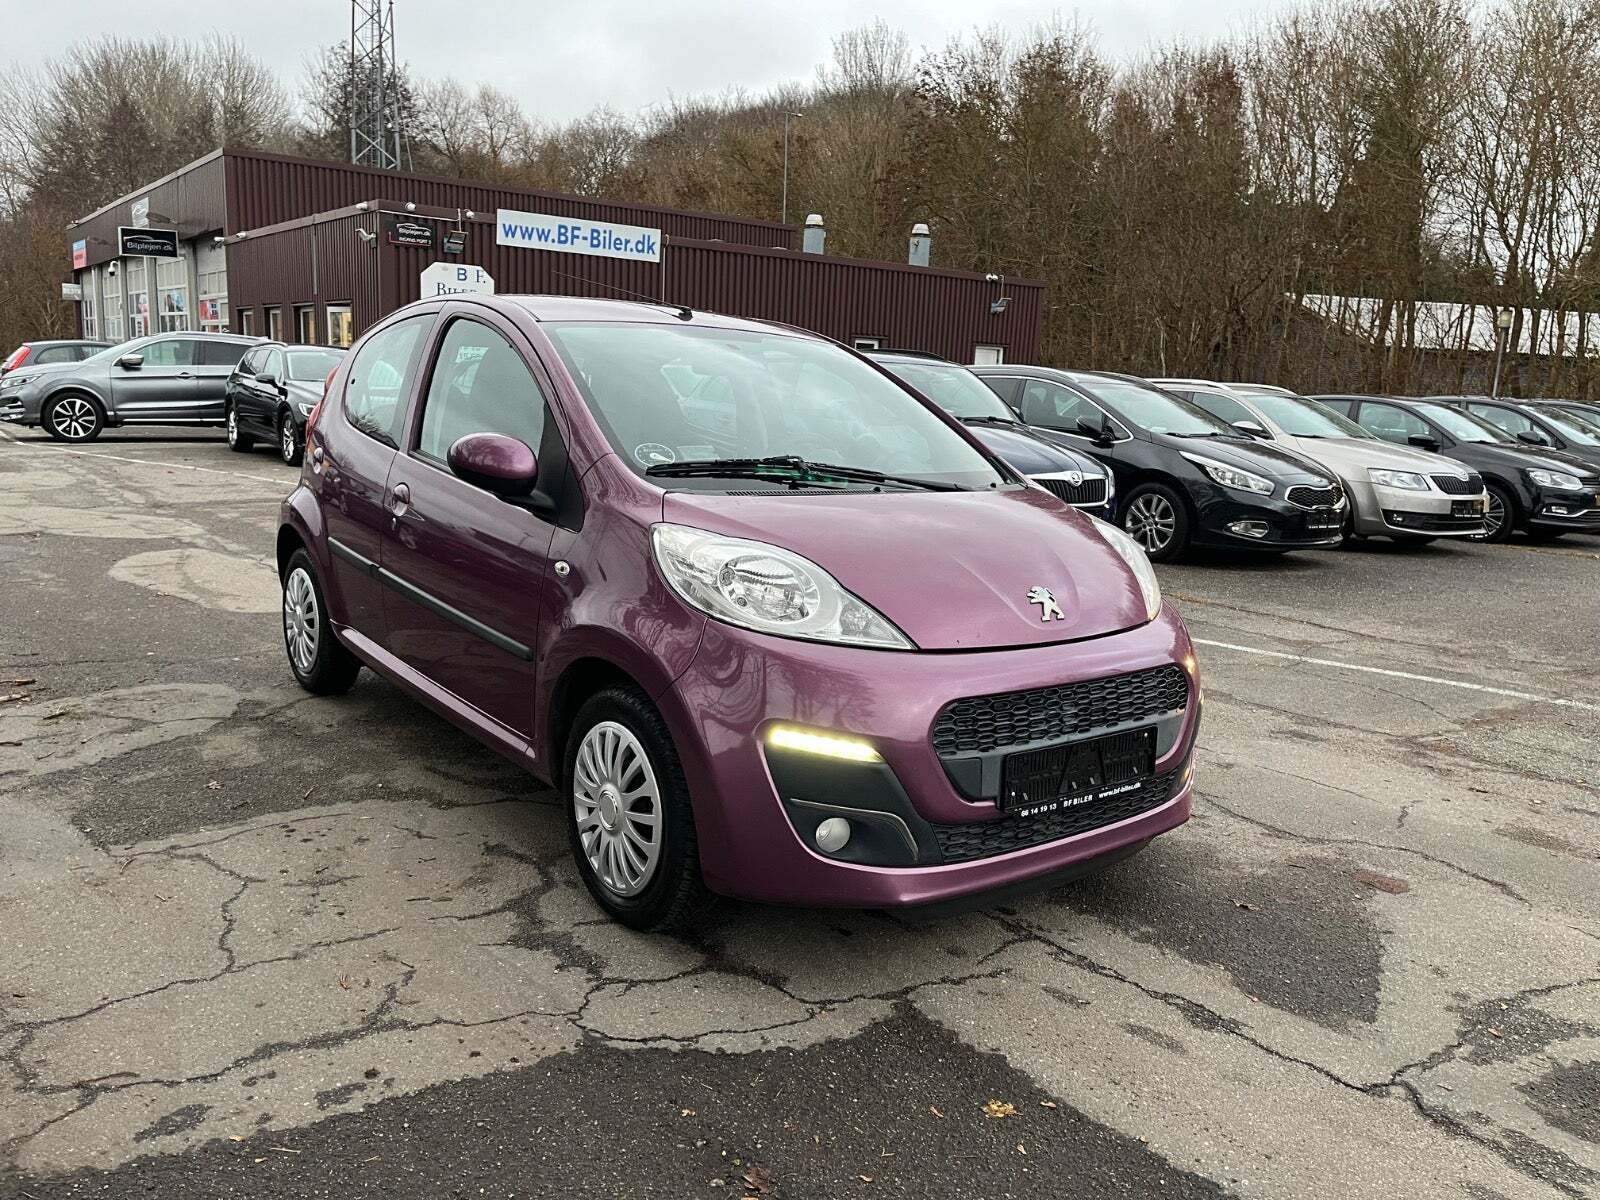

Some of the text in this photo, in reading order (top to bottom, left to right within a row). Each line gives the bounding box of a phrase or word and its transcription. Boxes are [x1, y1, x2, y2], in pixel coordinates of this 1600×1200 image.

[502, 223, 656, 255] www.BF-Biler.dk
[127, 241, 174, 252] Bilplejen.dk
[457, 267, 467, 281] B
[437, 282, 477, 296] BIL
[1030, 807, 1039, 815] 14
[1039, 805, 1048, 813] 19
[1049, 803, 1057, 811] 13
[1073, 794, 1093, 806] BILER
